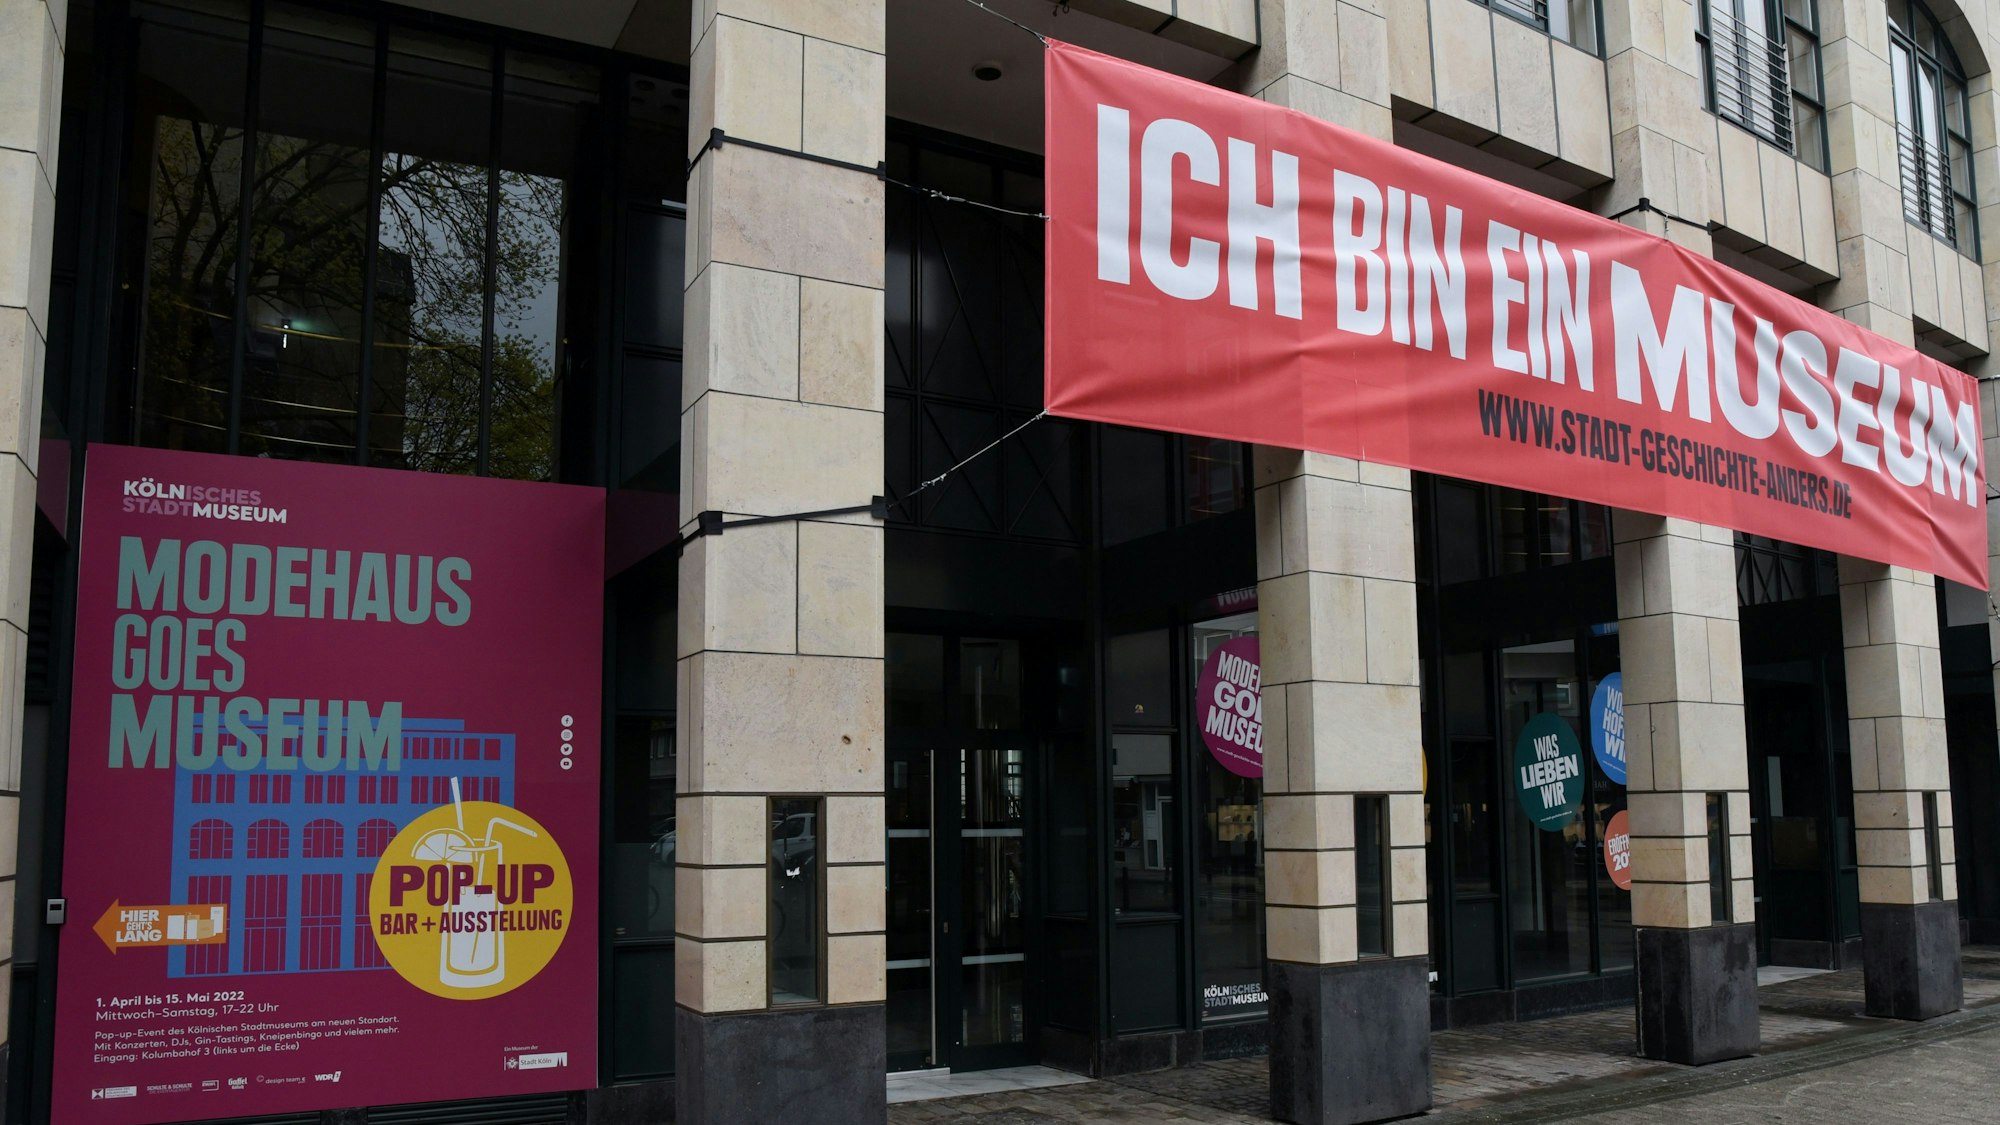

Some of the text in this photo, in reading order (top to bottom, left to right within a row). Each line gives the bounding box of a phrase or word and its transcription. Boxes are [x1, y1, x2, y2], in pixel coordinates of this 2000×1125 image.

[1097, 103, 1978, 508] ICH BIN EIN MUSEUM
[1478, 388, 1853, 519] WWW.STADT-GESCHICHTE-ANDERS.DE
[123, 477, 262, 505] KÖLNISCHES
[123, 497, 287, 524] STADTMUSEUM
[116, 536, 472, 627] MODEHAUS
[111, 613, 247, 693] GOES
[108, 693, 403, 772] MUSEUM
[1533, 733, 1560, 761] WAS
[1520, 753, 1579, 790] LIEBEN
[1540, 781, 1567, 810] WIR
[389, 863, 555, 907] POP-UP
[120, 909, 160, 922] HIER
[380, 909, 562, 935] BAR + AUSSTELLUNG
[115, 930, 162, 943] LANG
[96, 991, 244, 1009] 1. April bis 15. Mai 2022
[1204, 982, 1261, 998] KÖLNISCHES
[258, 1002, 279, 1013] Uhr
[94, 1026, 400, 1051] Mit Konzerten, DJs, Gin-Tastings, Kneipenbingo und vielem mehr.
[95, 1028, 165, 1041] Pop-up-Event
[167, 1026, 185, 1035] des
[187, 1024, 238, 1034] Kölnischen
[240, 1020, 309, 1031] Stadtmuseums
[328, 1018, 356, 1026] neuen
[358, 1015, 400, 1024] Standort.
[94, 1053, 139, 1064] Eingang:
[142, 1049, 201, 1060] Kolumbahof
[213, 1046, 237, 1055] (links
[258, 1044, 272, 1052] die
[274, 1041, 300, 1052] Ecke)
[315, 1074, 333, 1082] WDR
